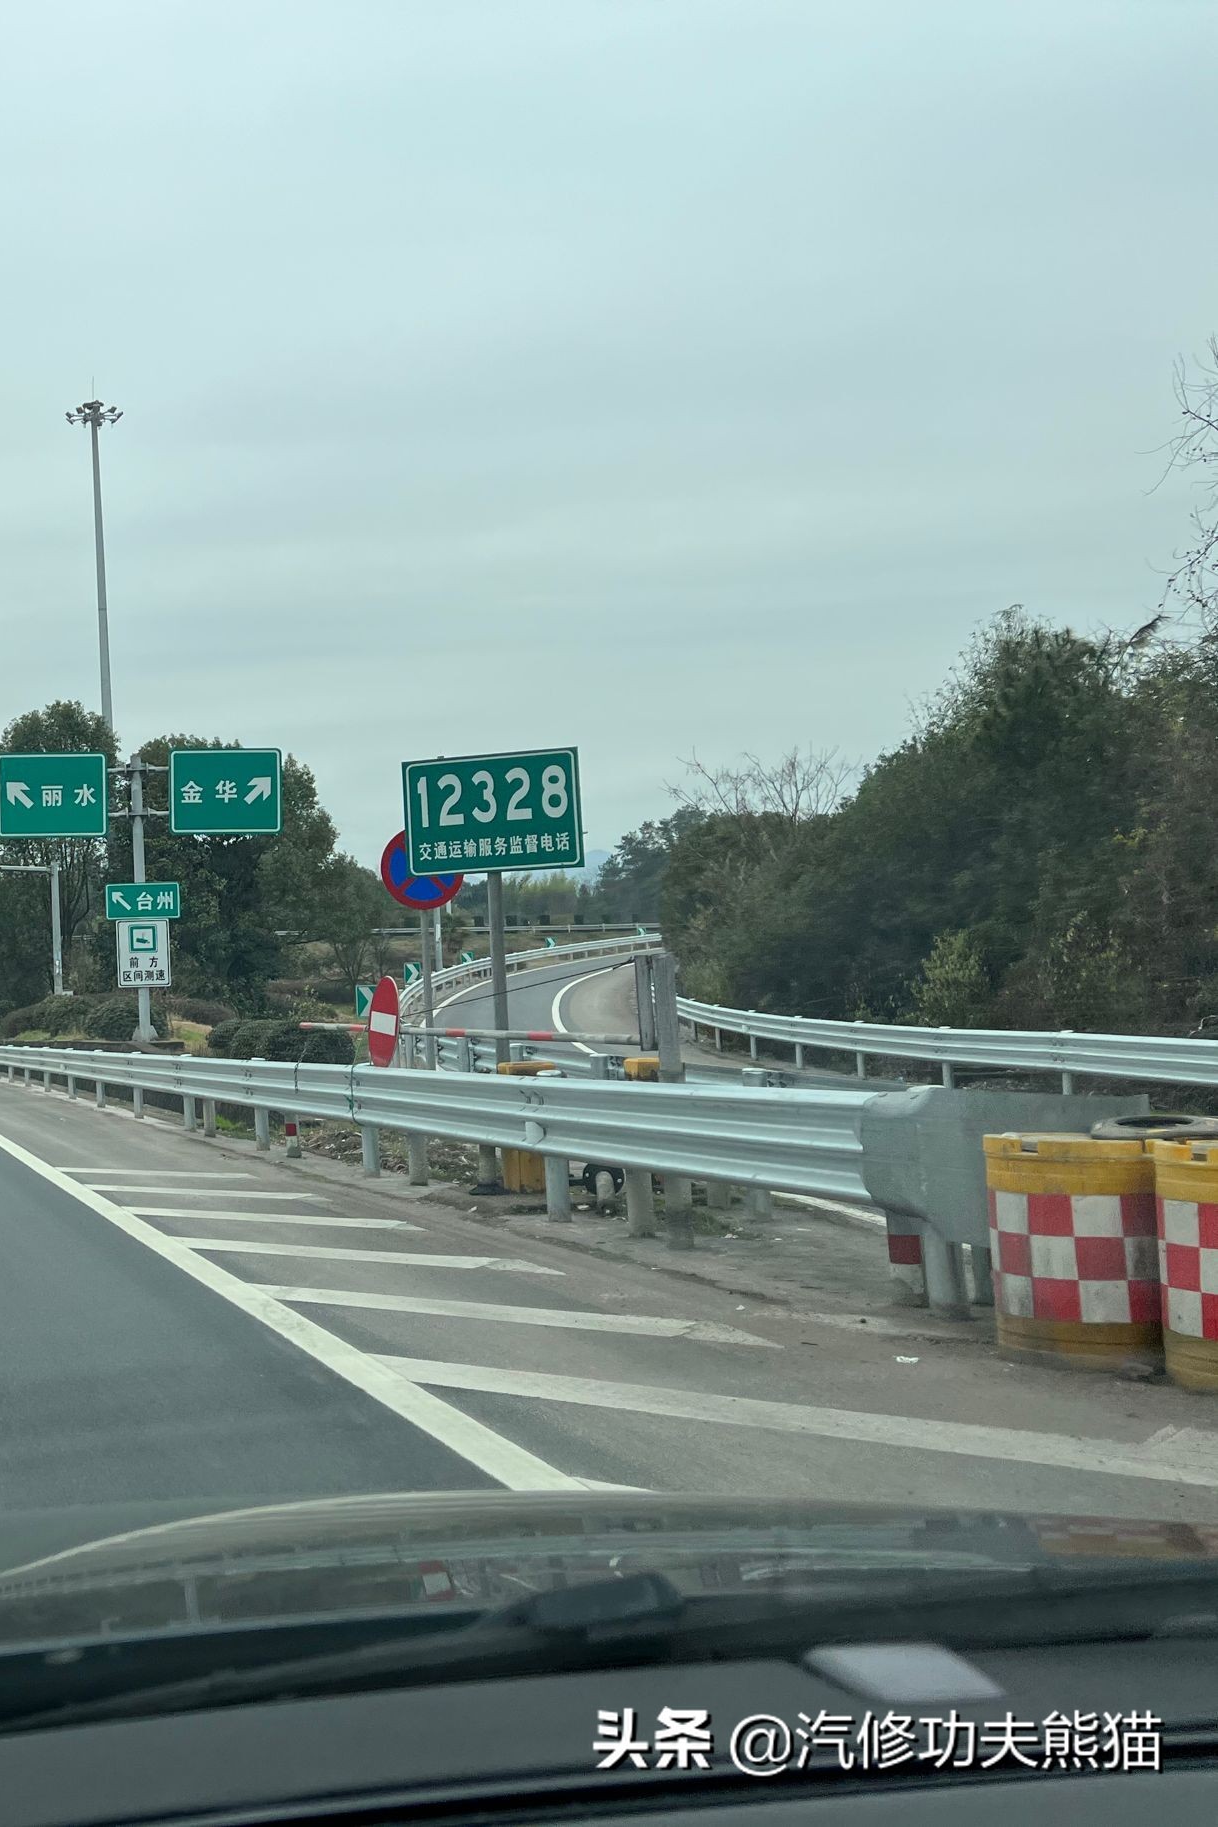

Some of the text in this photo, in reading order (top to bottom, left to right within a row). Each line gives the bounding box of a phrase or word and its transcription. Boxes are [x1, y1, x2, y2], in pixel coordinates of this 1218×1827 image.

[40, 783, 96, 807] 丽水
[180, 780, 238, 804] 金华
[417, 764, 569, 828] 12328
[419, 832, 571, 861] 交通运输服务监督电话
[136, 891, 174, 911] 台州
[123, 969, 166, 981] 区间测速
